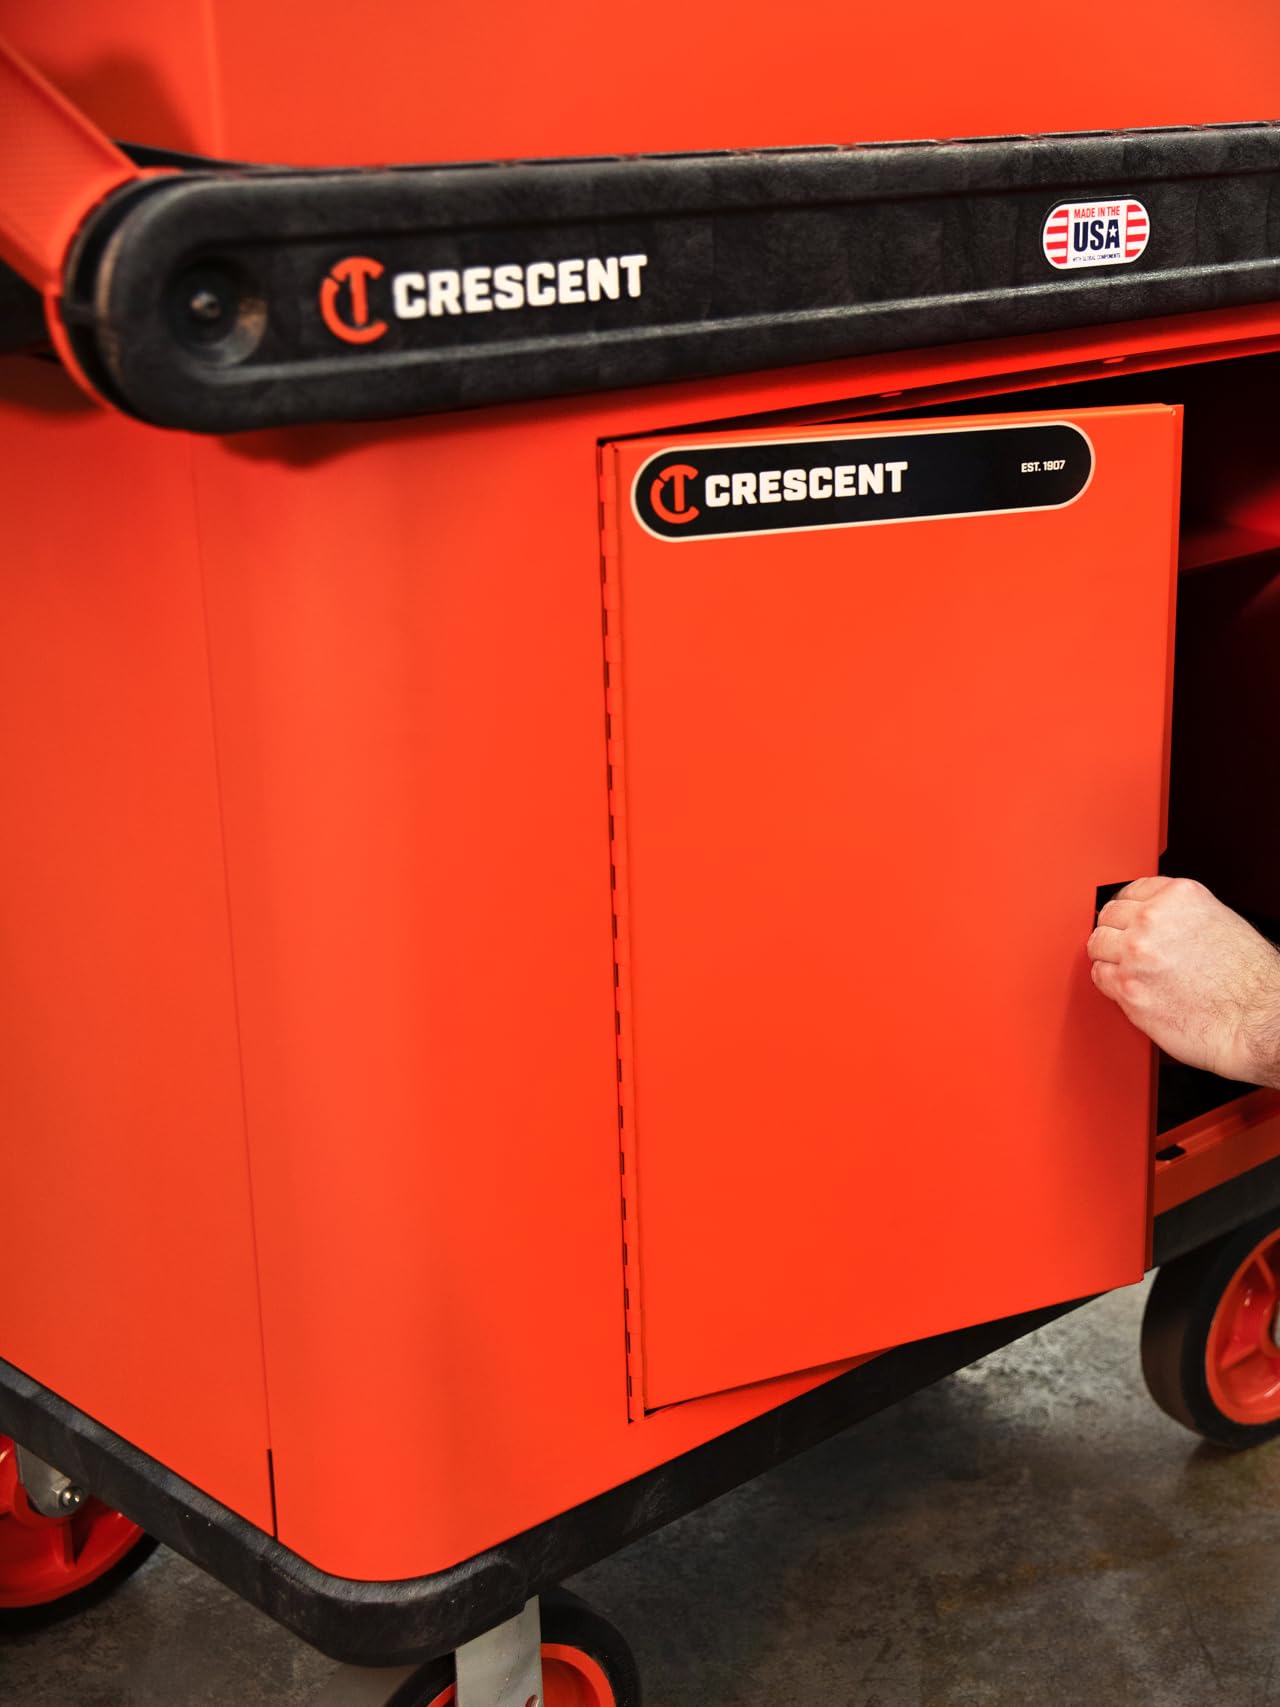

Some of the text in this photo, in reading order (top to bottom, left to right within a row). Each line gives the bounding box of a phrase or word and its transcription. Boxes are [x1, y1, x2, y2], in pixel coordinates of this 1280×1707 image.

[1074, 205, 1121, 219] MADE IN THE
[1074, 219, 1120, 252] USA
[392, 254, 648, 319] CRESCENT
[705, 460, 908, 508] CRESCENT
[1021, 461, 1042, 473] EST.
[1043, 459, 1066, 471] 1907
